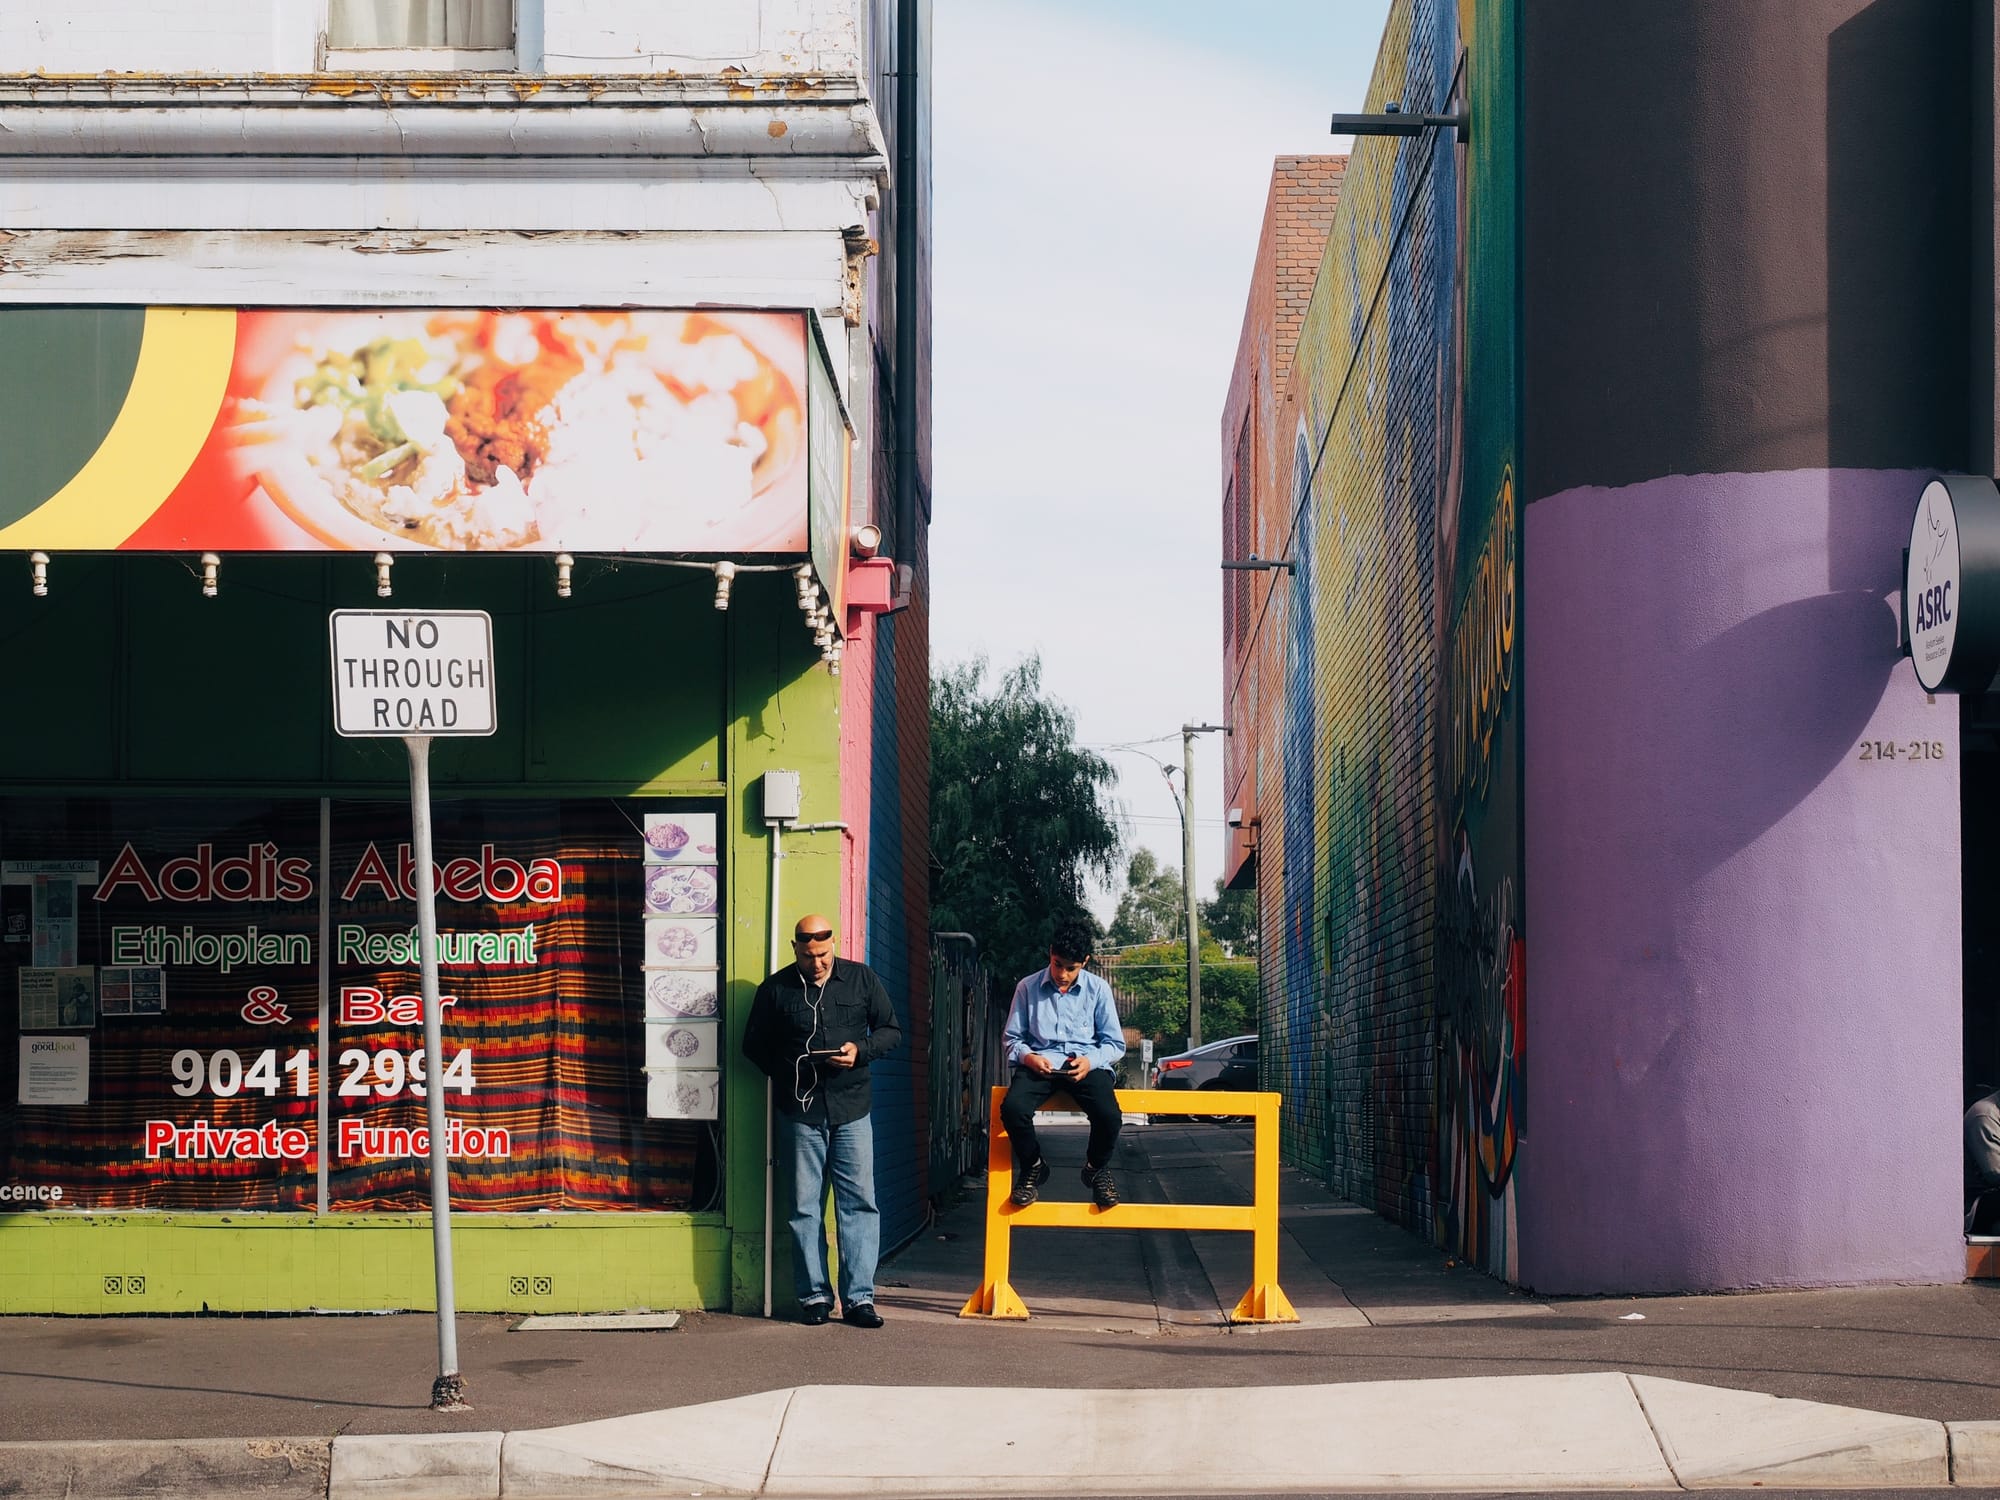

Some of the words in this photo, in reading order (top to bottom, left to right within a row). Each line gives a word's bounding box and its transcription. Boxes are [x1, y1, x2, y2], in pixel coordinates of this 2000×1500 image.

[1915, 580, 1951, 634] ASRC
[386, 619, 439, 649] NO
[343, 658, 485, 688] THROUGH
[373, 698, 458, 728] ROAD
[1859, 740, 1944, 760] 214-218
[93, 841, 313, 902] Addis
[341, 841, 562, 902] Abeba
[111, 925, 311, 974] Ethiopian
[241, 986, 293, 1025] &
[171, 1049, 310, 1098] 9041
[145, 1119, 309, 1160] Private
[337, 1118, 511, 1158] Funcion
